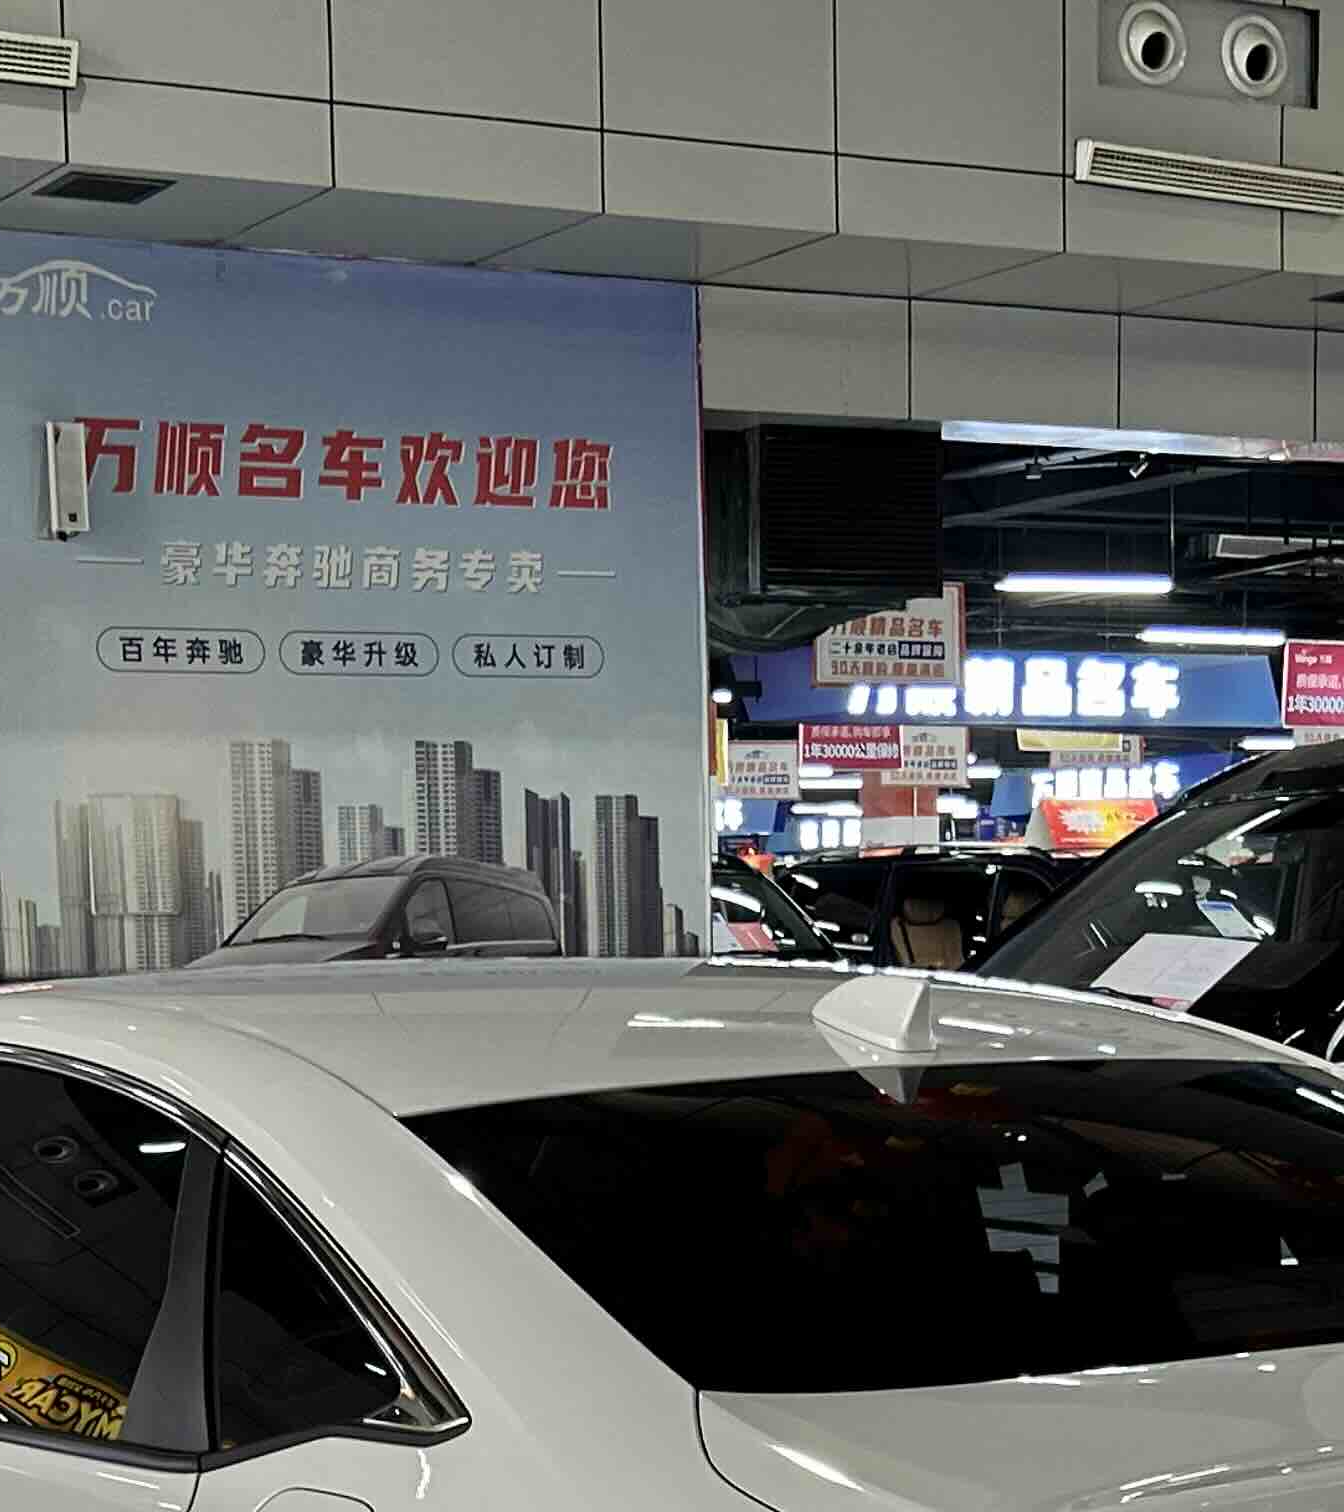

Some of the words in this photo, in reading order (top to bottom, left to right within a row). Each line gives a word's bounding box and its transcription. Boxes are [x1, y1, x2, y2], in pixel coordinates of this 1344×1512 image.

[72, 417, 613, 510] 万顺名车欢迎您
[159, 541, 546, 595] 豪华奔驰商务专卖
[119, 636, 244, 665] 百年奔驰
[300, 640, 420, 669] 豪华升级
[473, 644, 587, 670] 私人订制
